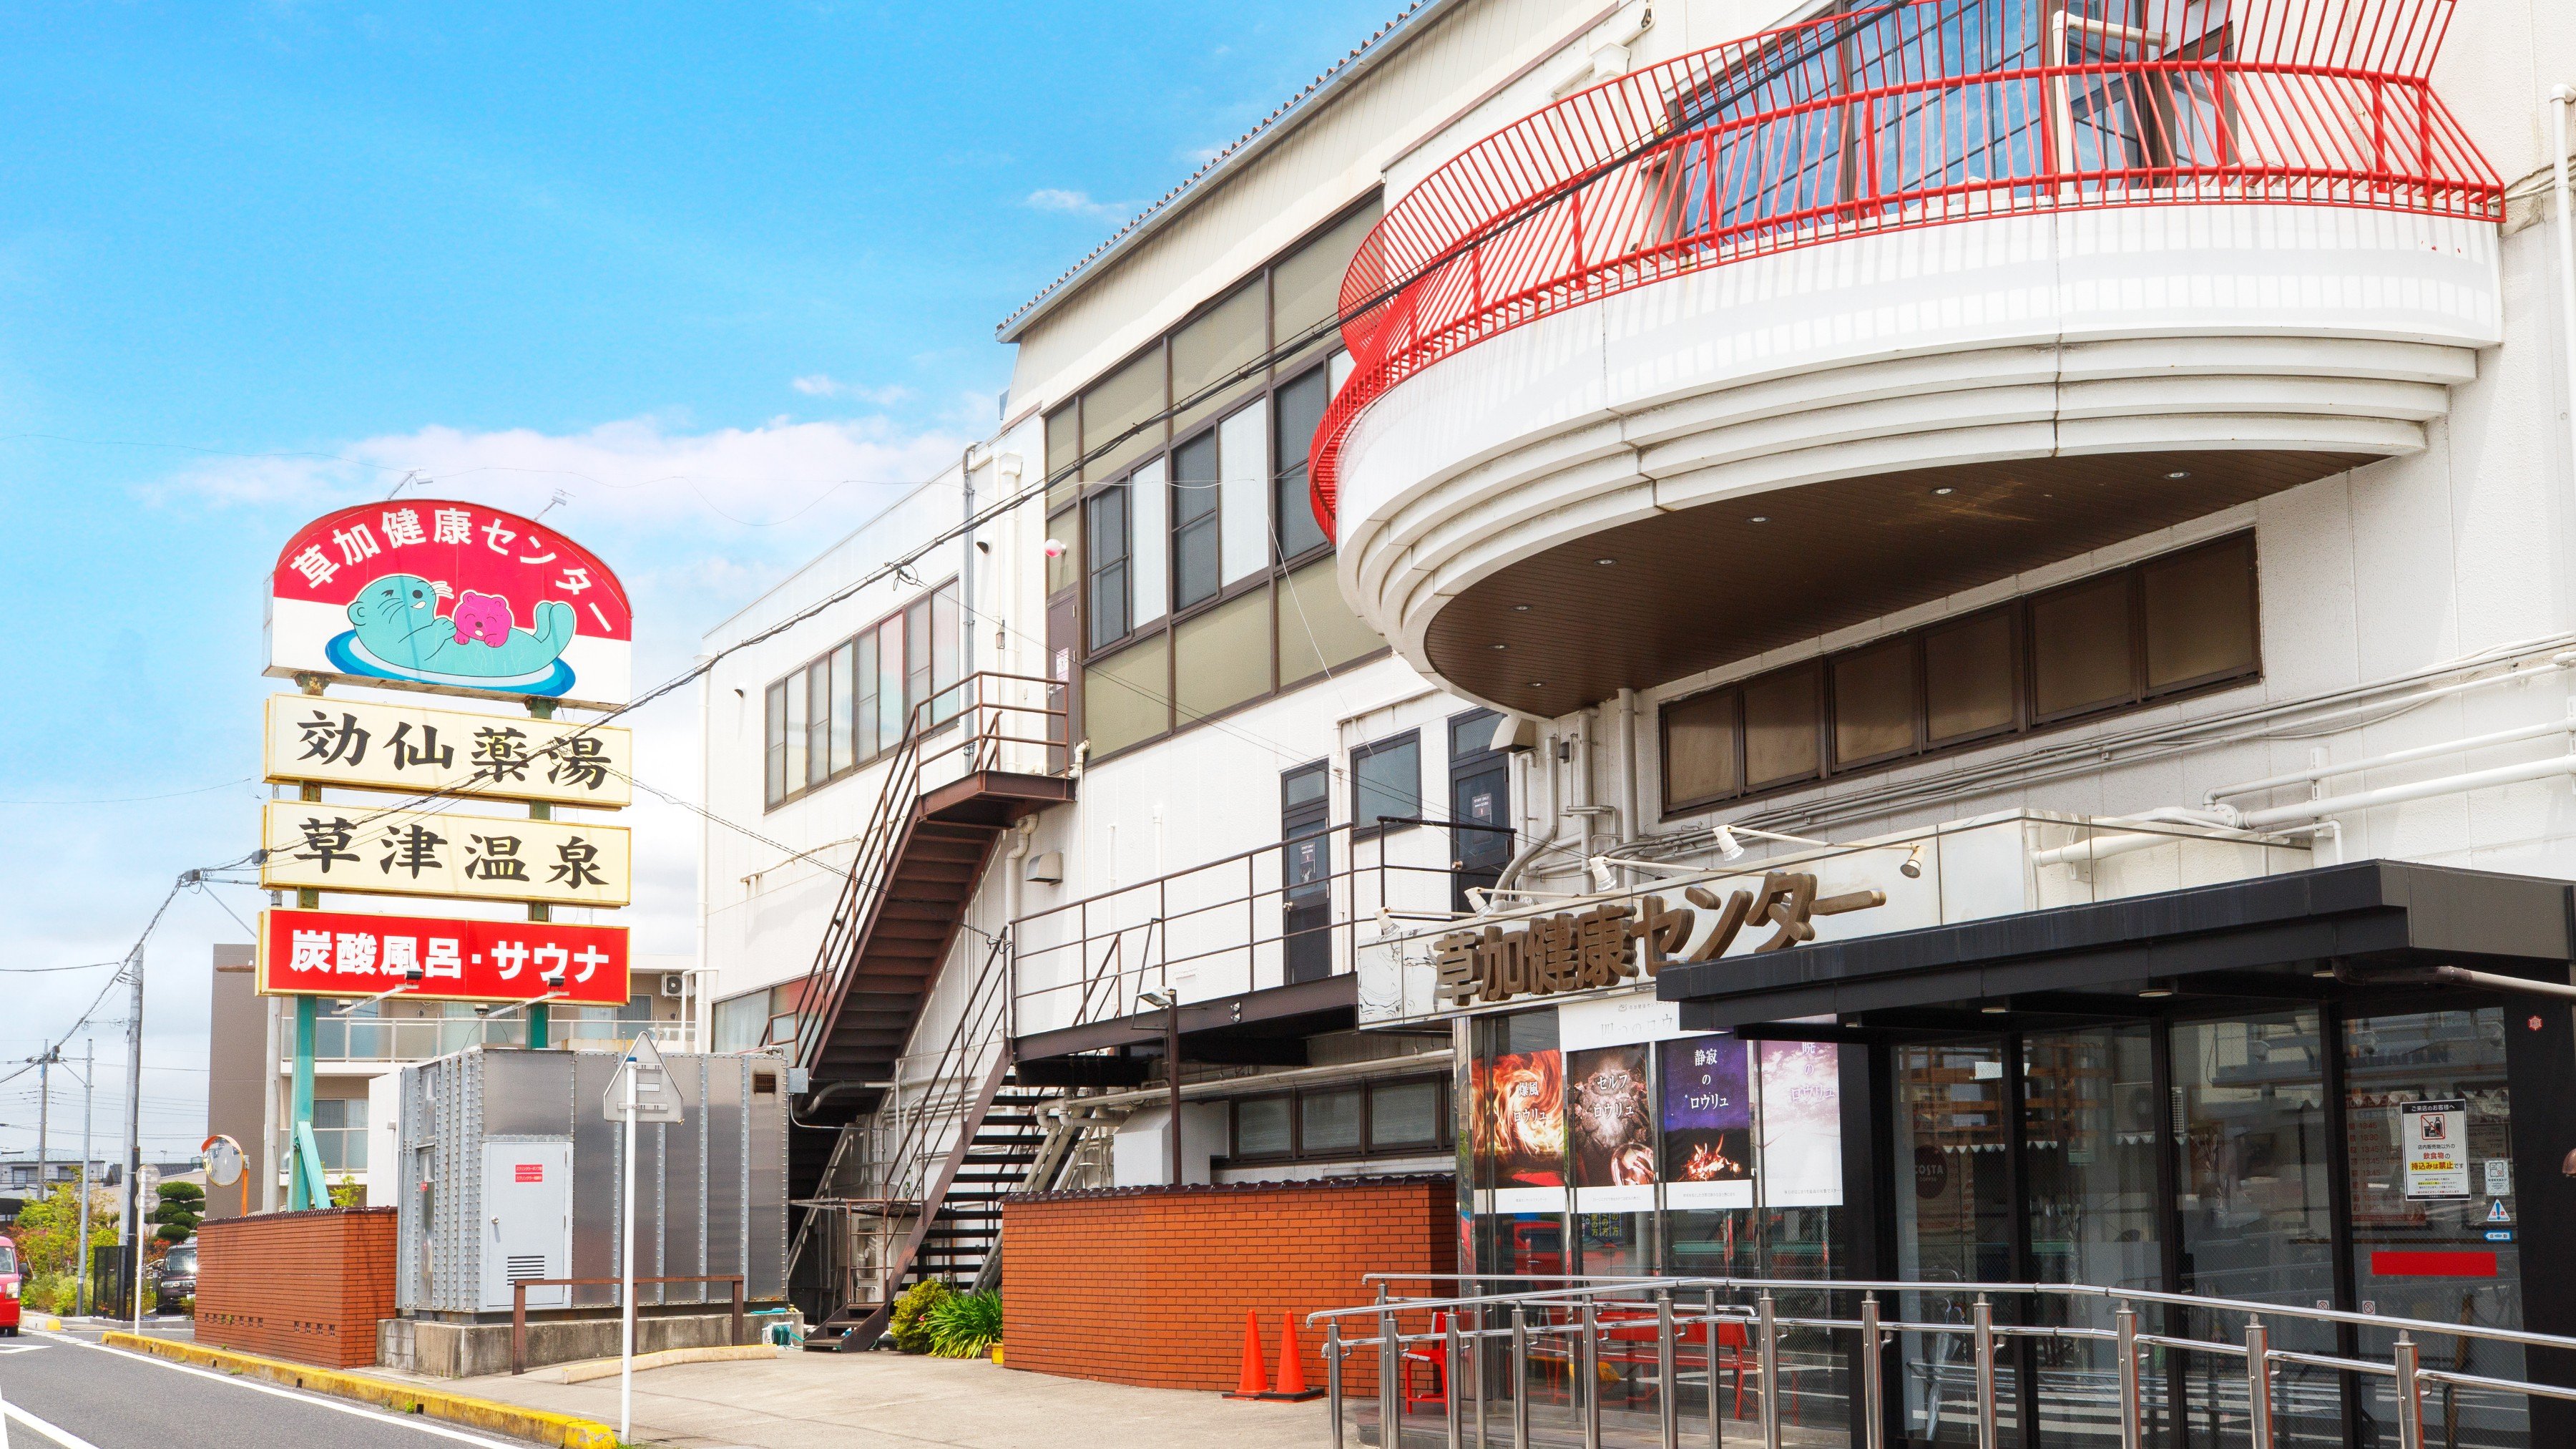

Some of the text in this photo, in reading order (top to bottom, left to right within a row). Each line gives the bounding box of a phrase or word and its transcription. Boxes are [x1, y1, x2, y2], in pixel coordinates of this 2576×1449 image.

[290, 507, 612, 633] 草加健康センター
[296, 710, 611, 790] 効仙薬湯
[293, 816, 609, 889] 草津温泉
[1433, 872, 1886, 1007] 草加健康センター
[290, 930, 609, 983] 炭酸風呂・サウナ
[1694, 1048, 1718, 1066] 静寂
[1804, 1063, 1815, 1075] の
[1518, 1080, 1539, 1097] 爆風
[1597, 1074, 1628, 1091] セルフ
[1702, 1074, 1711, 1085] の
[1790, 1083, 1835, 1102] ロウリュ
[1594, 1103, 1635, 1118] ロウリュ
[1690, 1093, 1729, 1111] ロウリュ
[1513, 1108, 1547, 1123] ロウリュ
[2411, 1161, 2464, 1170] 持込みは禁止です
